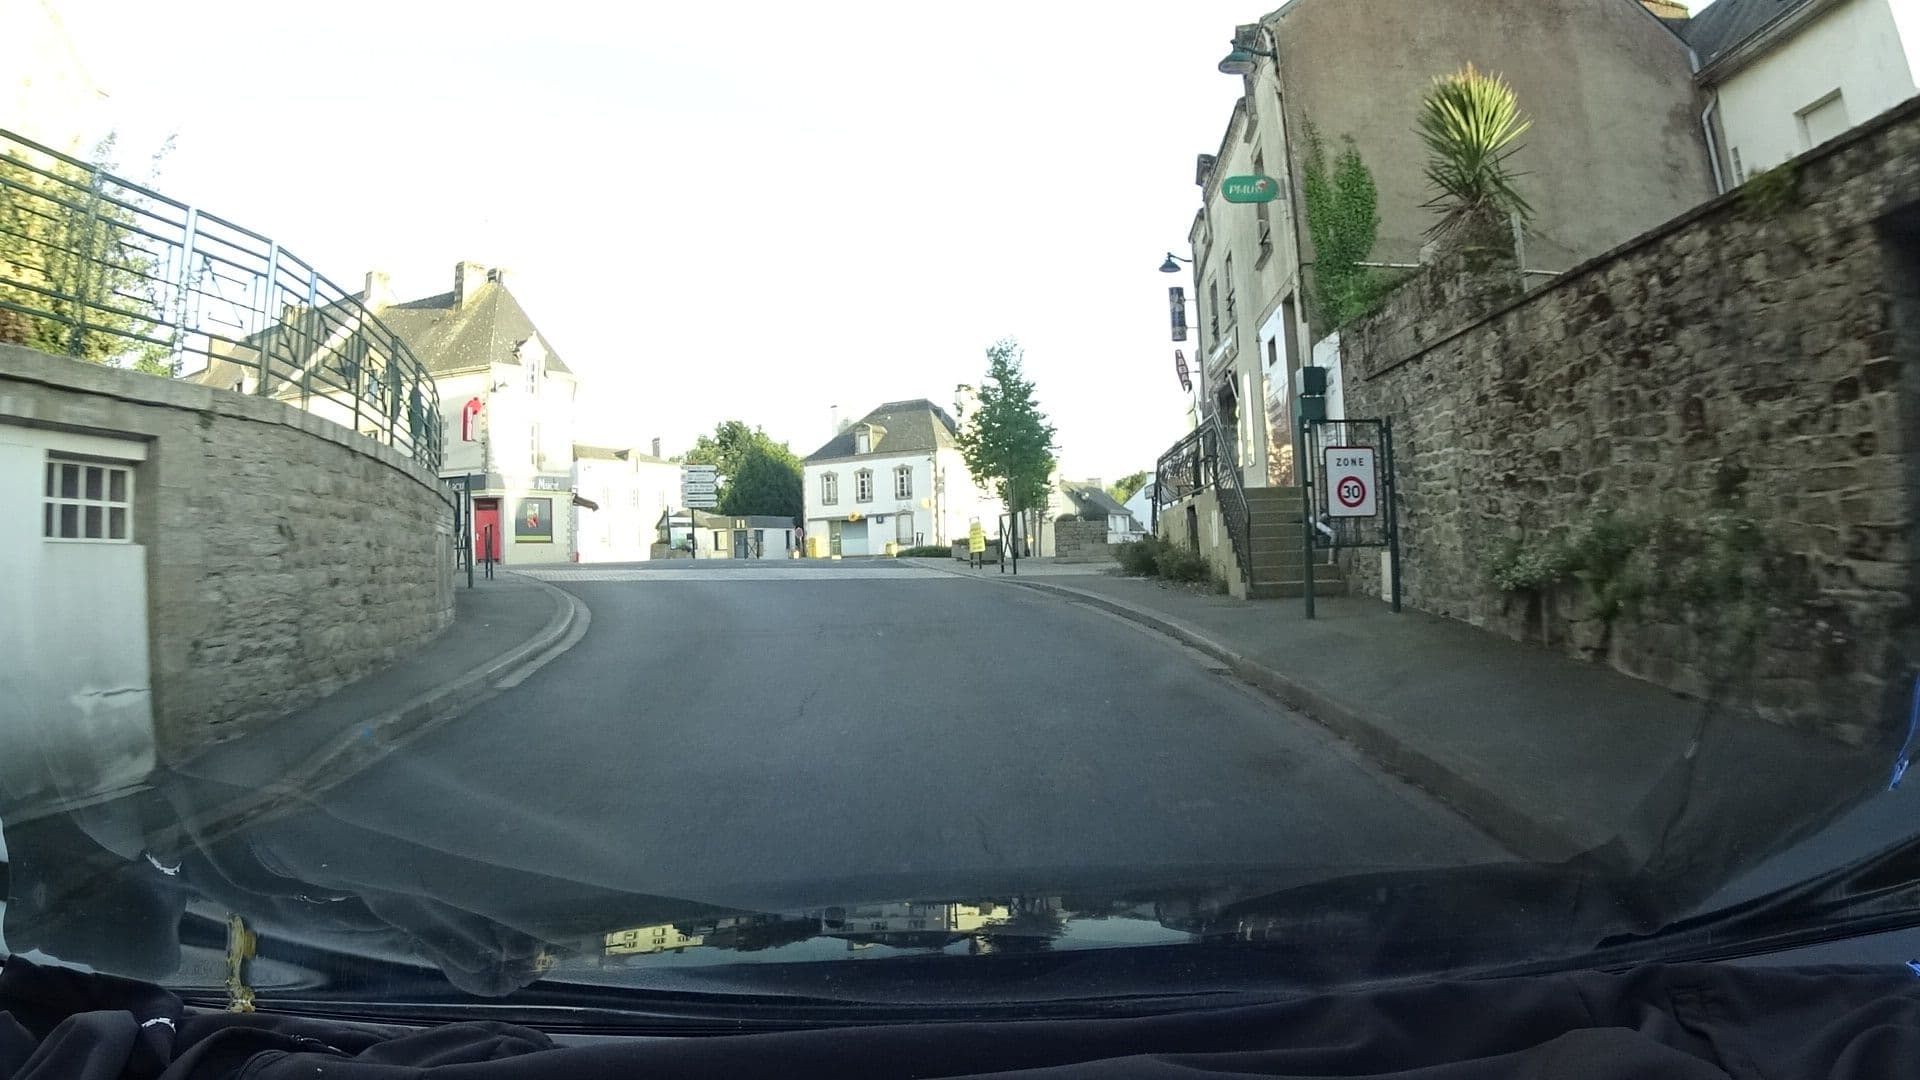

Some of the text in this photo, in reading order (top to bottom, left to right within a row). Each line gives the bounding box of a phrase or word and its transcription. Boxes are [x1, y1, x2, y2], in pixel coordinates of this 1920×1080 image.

[1229, 184, 1255, 194] PMU
[1336, 457, 1364, 467] ZONE
[1343, 485, 1361, 499] 30
